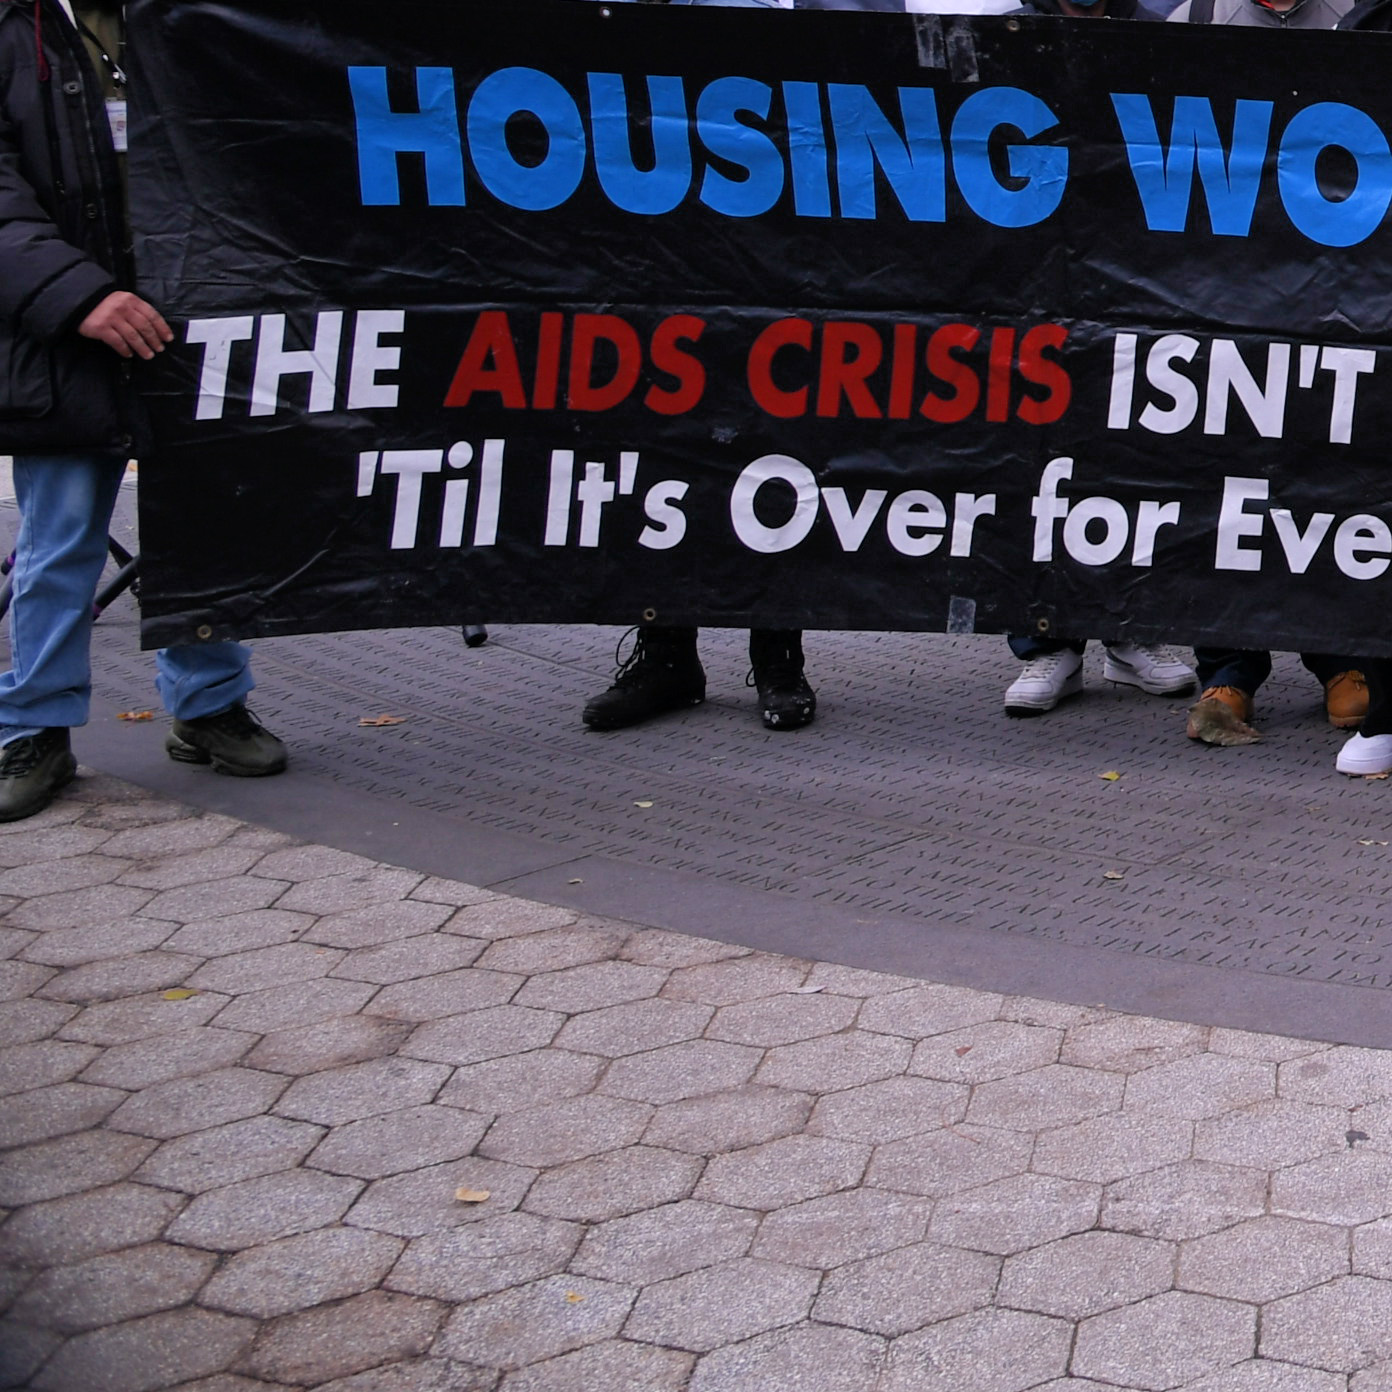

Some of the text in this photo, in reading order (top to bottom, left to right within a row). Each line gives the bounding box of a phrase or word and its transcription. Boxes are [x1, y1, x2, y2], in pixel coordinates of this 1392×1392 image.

[348, 65, 1069, 228] HOUSING
[186, 309, 405, 420] THE
[444, 311, 706, 416] AIDS
[747, 318, 1073, 426] CRISIS
[1106, 333, 1377, 444] ISN'T
[356, 439, 506, 550] 'Til
[543, 448, 689, 550] It's
[730, 453, 996, 559] Over
[1030, 456, 1181, 569] for
[1264, 961, 1312, 975] OF
[1333, 950, 1384, 964] TO
